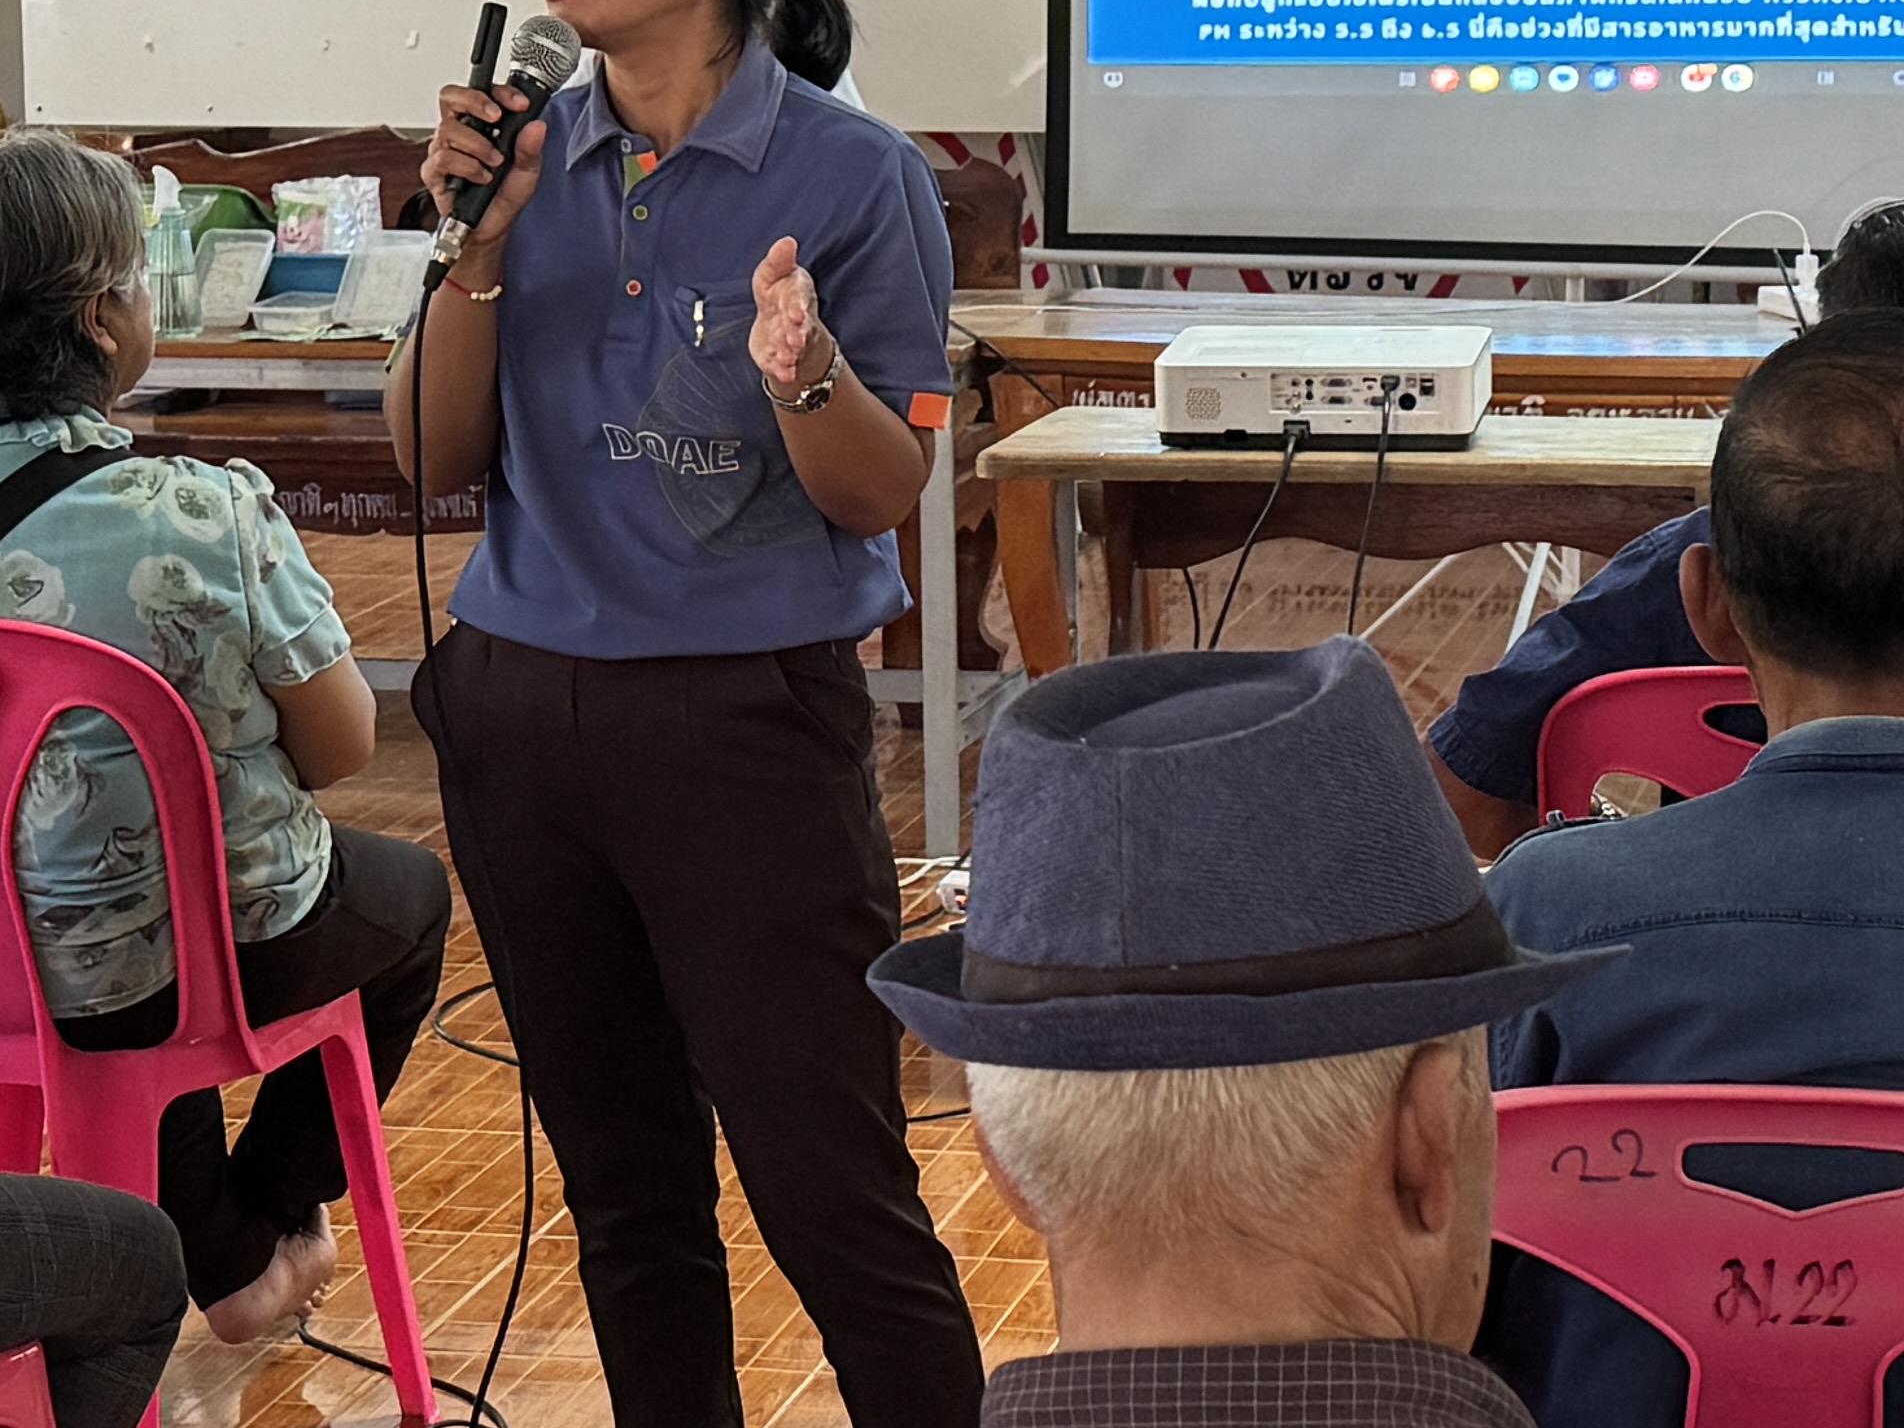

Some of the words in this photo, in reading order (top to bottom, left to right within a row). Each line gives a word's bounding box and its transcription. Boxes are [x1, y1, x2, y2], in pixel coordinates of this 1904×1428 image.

[1335, 22, 1374, 40] 5.5
[602, 422, 742, 475] DOAE
[1551, 1128, 1657, 1184] 22
